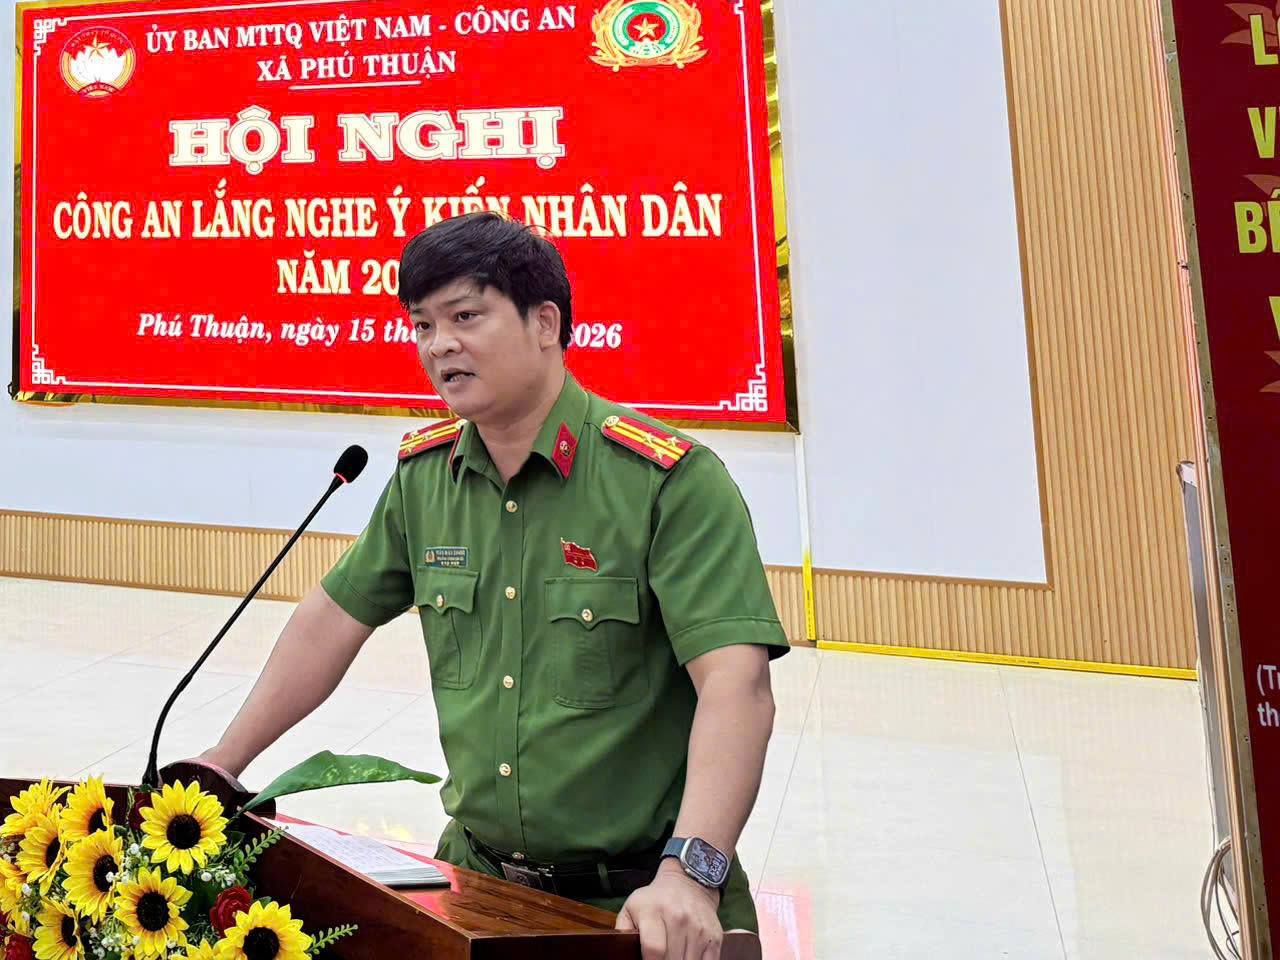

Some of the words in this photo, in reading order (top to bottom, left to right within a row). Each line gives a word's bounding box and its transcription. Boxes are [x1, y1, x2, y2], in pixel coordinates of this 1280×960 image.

[145, 23, 177, 54] ỦY
[183, 26, 230, 51] BAN
[236, 23, 304, 50] MTTQ
[307, 13, 368, 47] VIỆT
[374, 13, 432, 41] NAM
[454, 4, 531, 36] CÔNG
[537, 5, 576, 31] AN
[256, 55, 292, 82] XÃ
[300, 50, 356, 79] PHÚ
[363, 46, 457, 79] THUẬN
[169, 104, 316, 176] HỘI
[337, 106, 566, 170] NGHỊ
[53, 191, 133, 239] CÔNG
[141, 200, 182, 238] AN
[191, 177, 276, 238] LẮNG
[285, 196, 379, 238] NGHE
[386, 184, 412, 238] Ý
[521, 182, 627, 238] NHÂN
[641, 181, 723, 238] DÂN
[276, 249, 351, 295] NĂM
[361, 258, 400, 296] 20
[136, 312, 183, 338] Phú
[189, 313, 273, 343] Thuận,
[280, 316, 340, 347] ngày
[349, 318, 376, 342] 15
[567, 322, 623, 349] 026
